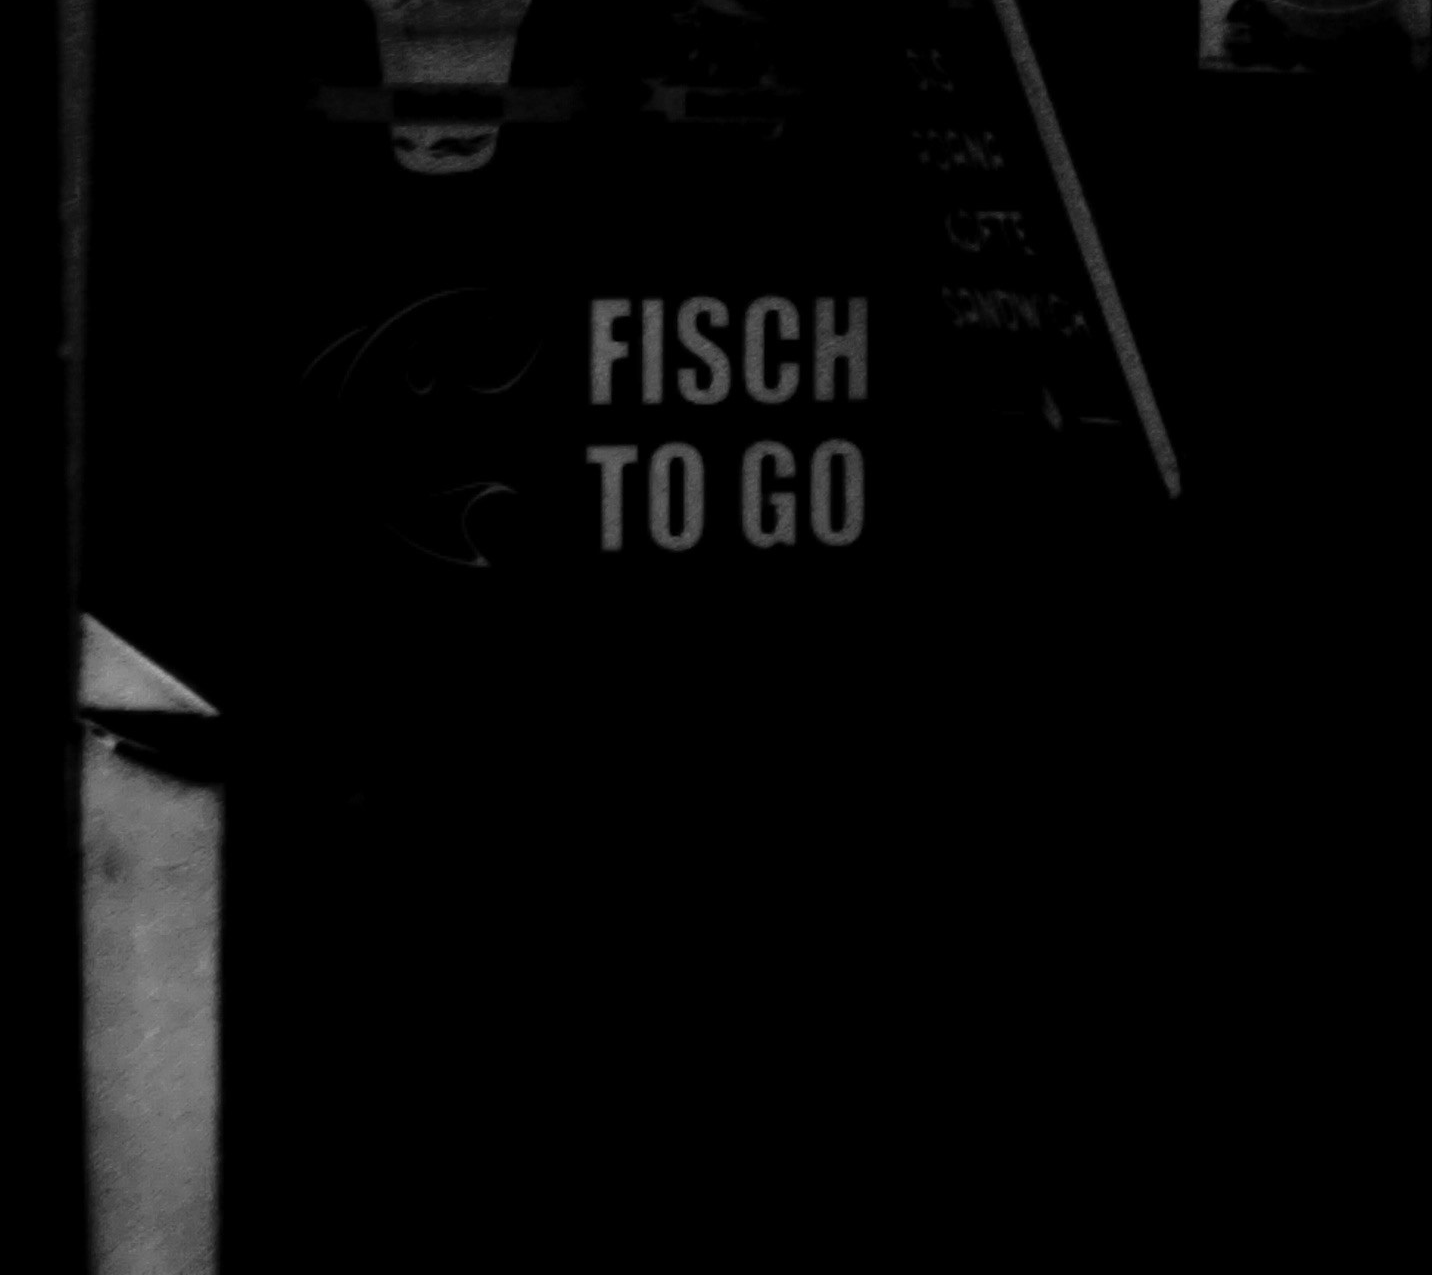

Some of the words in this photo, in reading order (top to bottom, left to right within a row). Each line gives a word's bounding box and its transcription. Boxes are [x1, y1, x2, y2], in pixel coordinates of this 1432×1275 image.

[586, 294, 871, 408] FISCH
[583, 439, 708, 555] TO
[736, 437, 869, 550] GO
